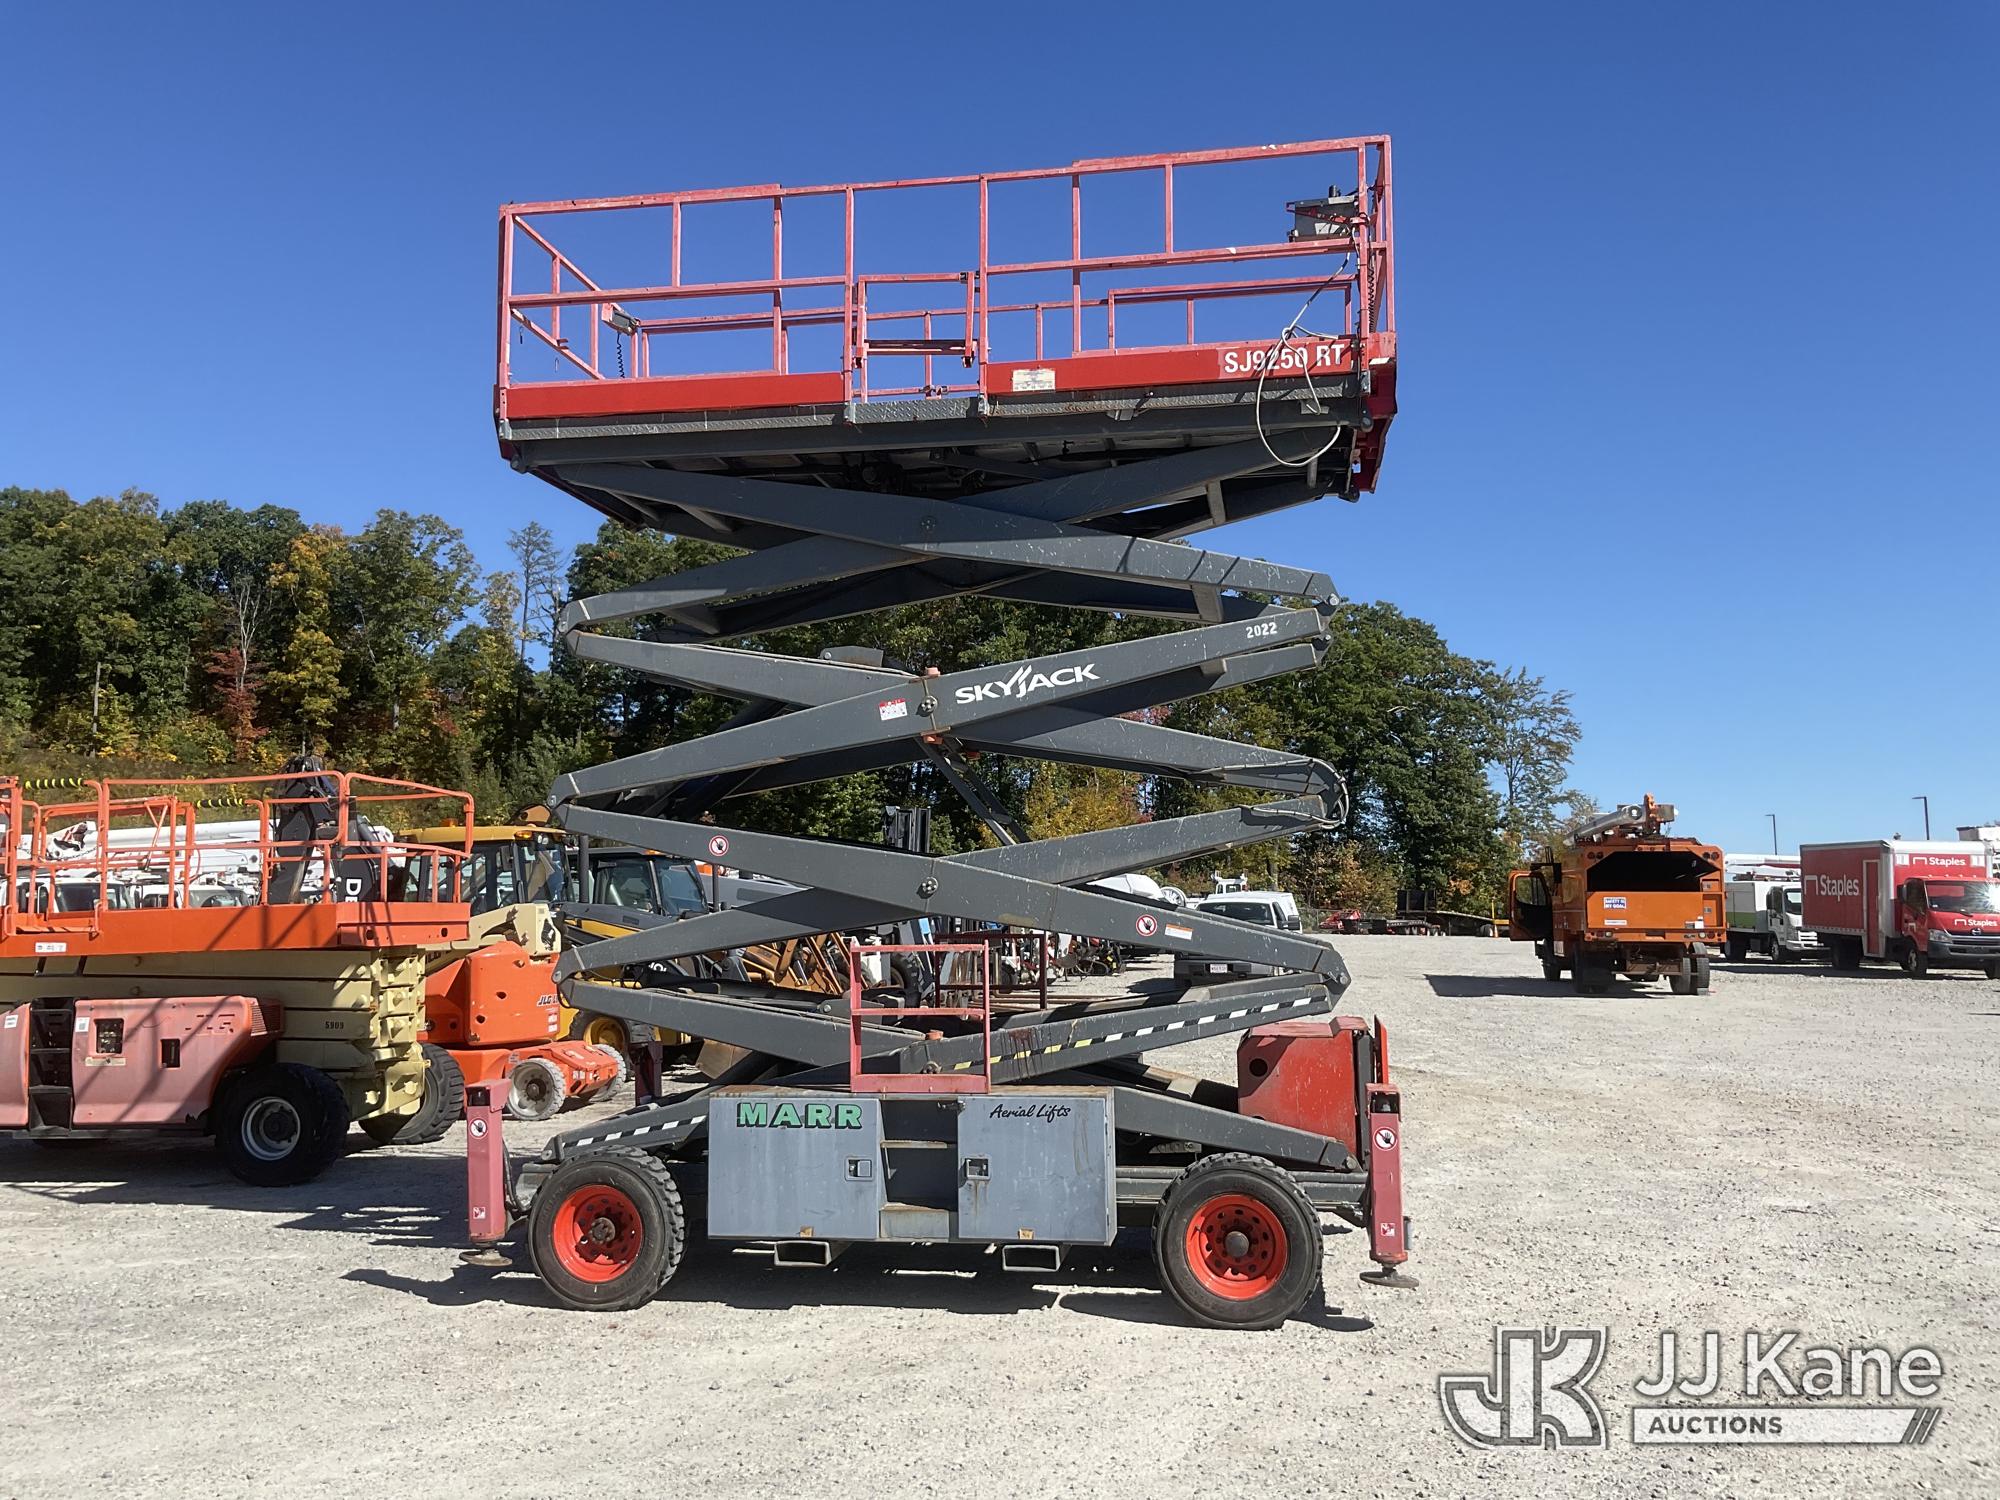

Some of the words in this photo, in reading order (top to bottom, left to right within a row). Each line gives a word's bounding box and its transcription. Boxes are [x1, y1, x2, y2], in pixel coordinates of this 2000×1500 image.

[1224, 347, 1308, 373] SJ9250
[1316, 344, 1344, 367] RT
[1246, 621, 1278, 639] 2022
[955, 664, 1100, 704] SKYJACK
[1929, 856, 1966, 868] Staples
[1820, 874, 1860, 902] Staples
[1967, 918, 1998, 928] Staples
[737, 1102, 862, 1130] MARR
[989, 1103, 1036, 1119] Aerial
[1036, 1103, 1071, 1123] Lifts
